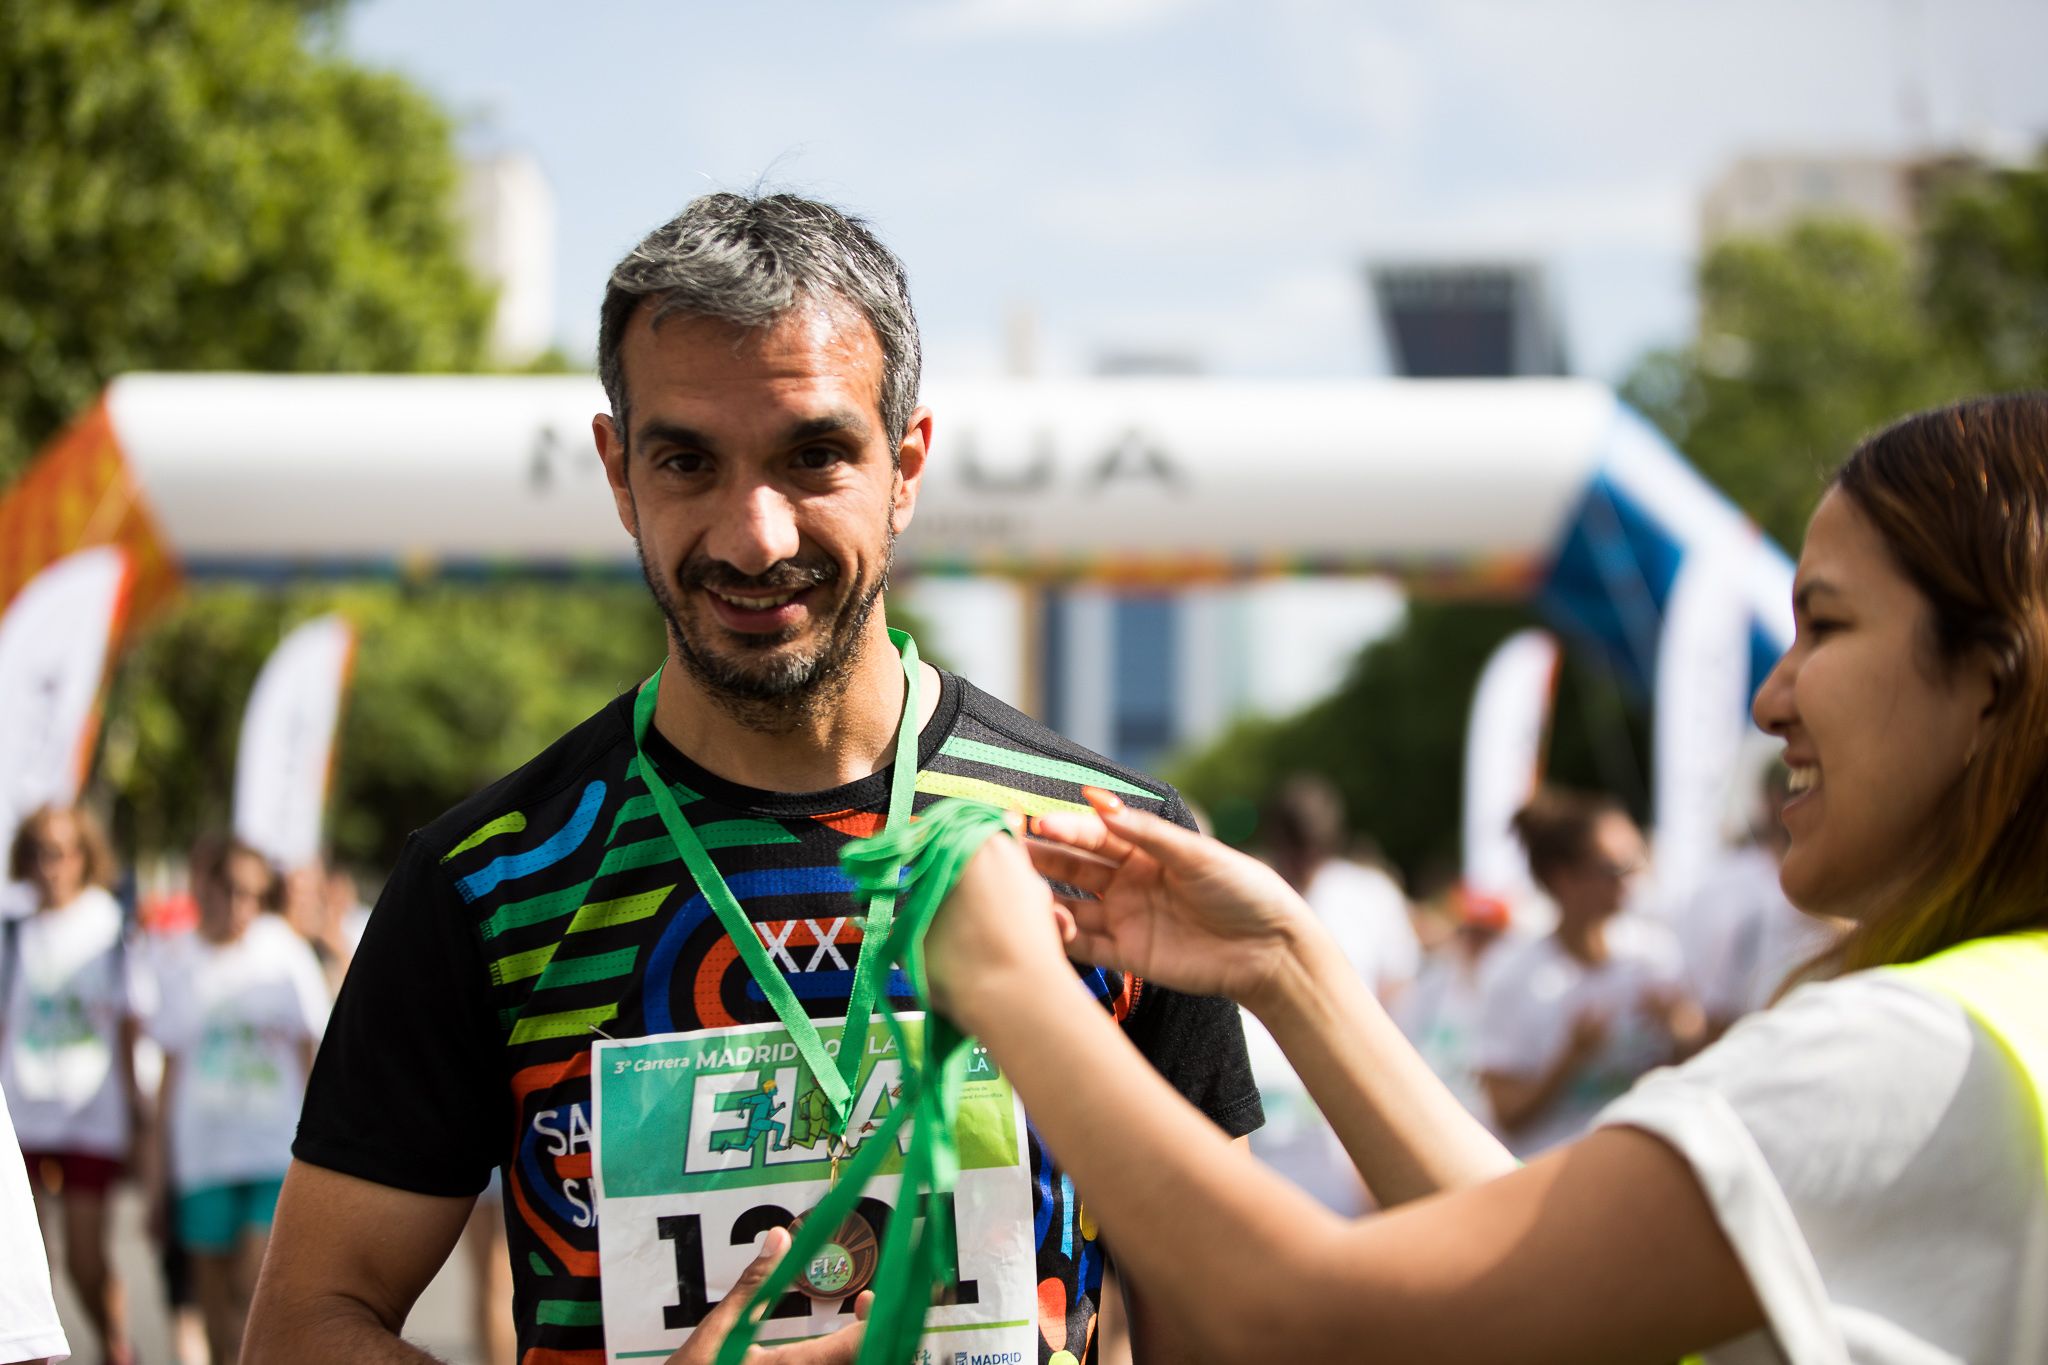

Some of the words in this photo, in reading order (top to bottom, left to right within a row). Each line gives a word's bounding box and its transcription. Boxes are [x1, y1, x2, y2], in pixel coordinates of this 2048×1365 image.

[633, 1056, 691, 1073] Carrera
[695, 1042, 799, 1070] MADRID
[683, 1055, 912, 1175] ELA
